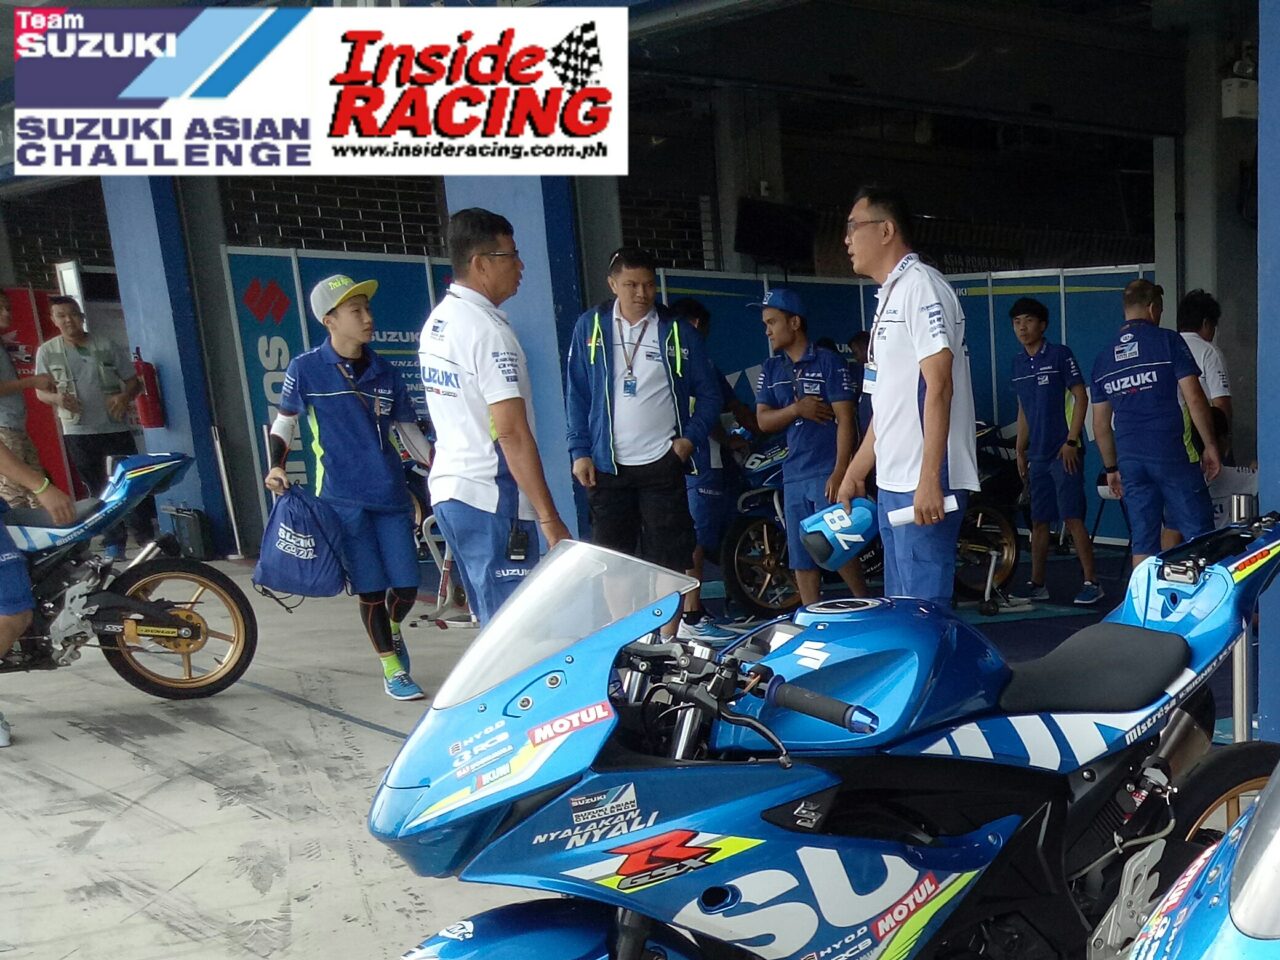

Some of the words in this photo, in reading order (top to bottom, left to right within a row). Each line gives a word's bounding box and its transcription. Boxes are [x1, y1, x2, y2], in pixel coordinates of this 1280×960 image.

[422, 366, 461, 389] UZUKI
[1104, 371, 1157, 395] SUZUKI
[495, 568, 530, 578] SUZUK
[533, 703, 609, 744] MOTUL
[572, 794, 607, 807] SUZUKI
[564, 810, 660, 850] NYALI
[877, 878, 936, 937] MOTUL
[820, 925, 868, 957] HYOD
